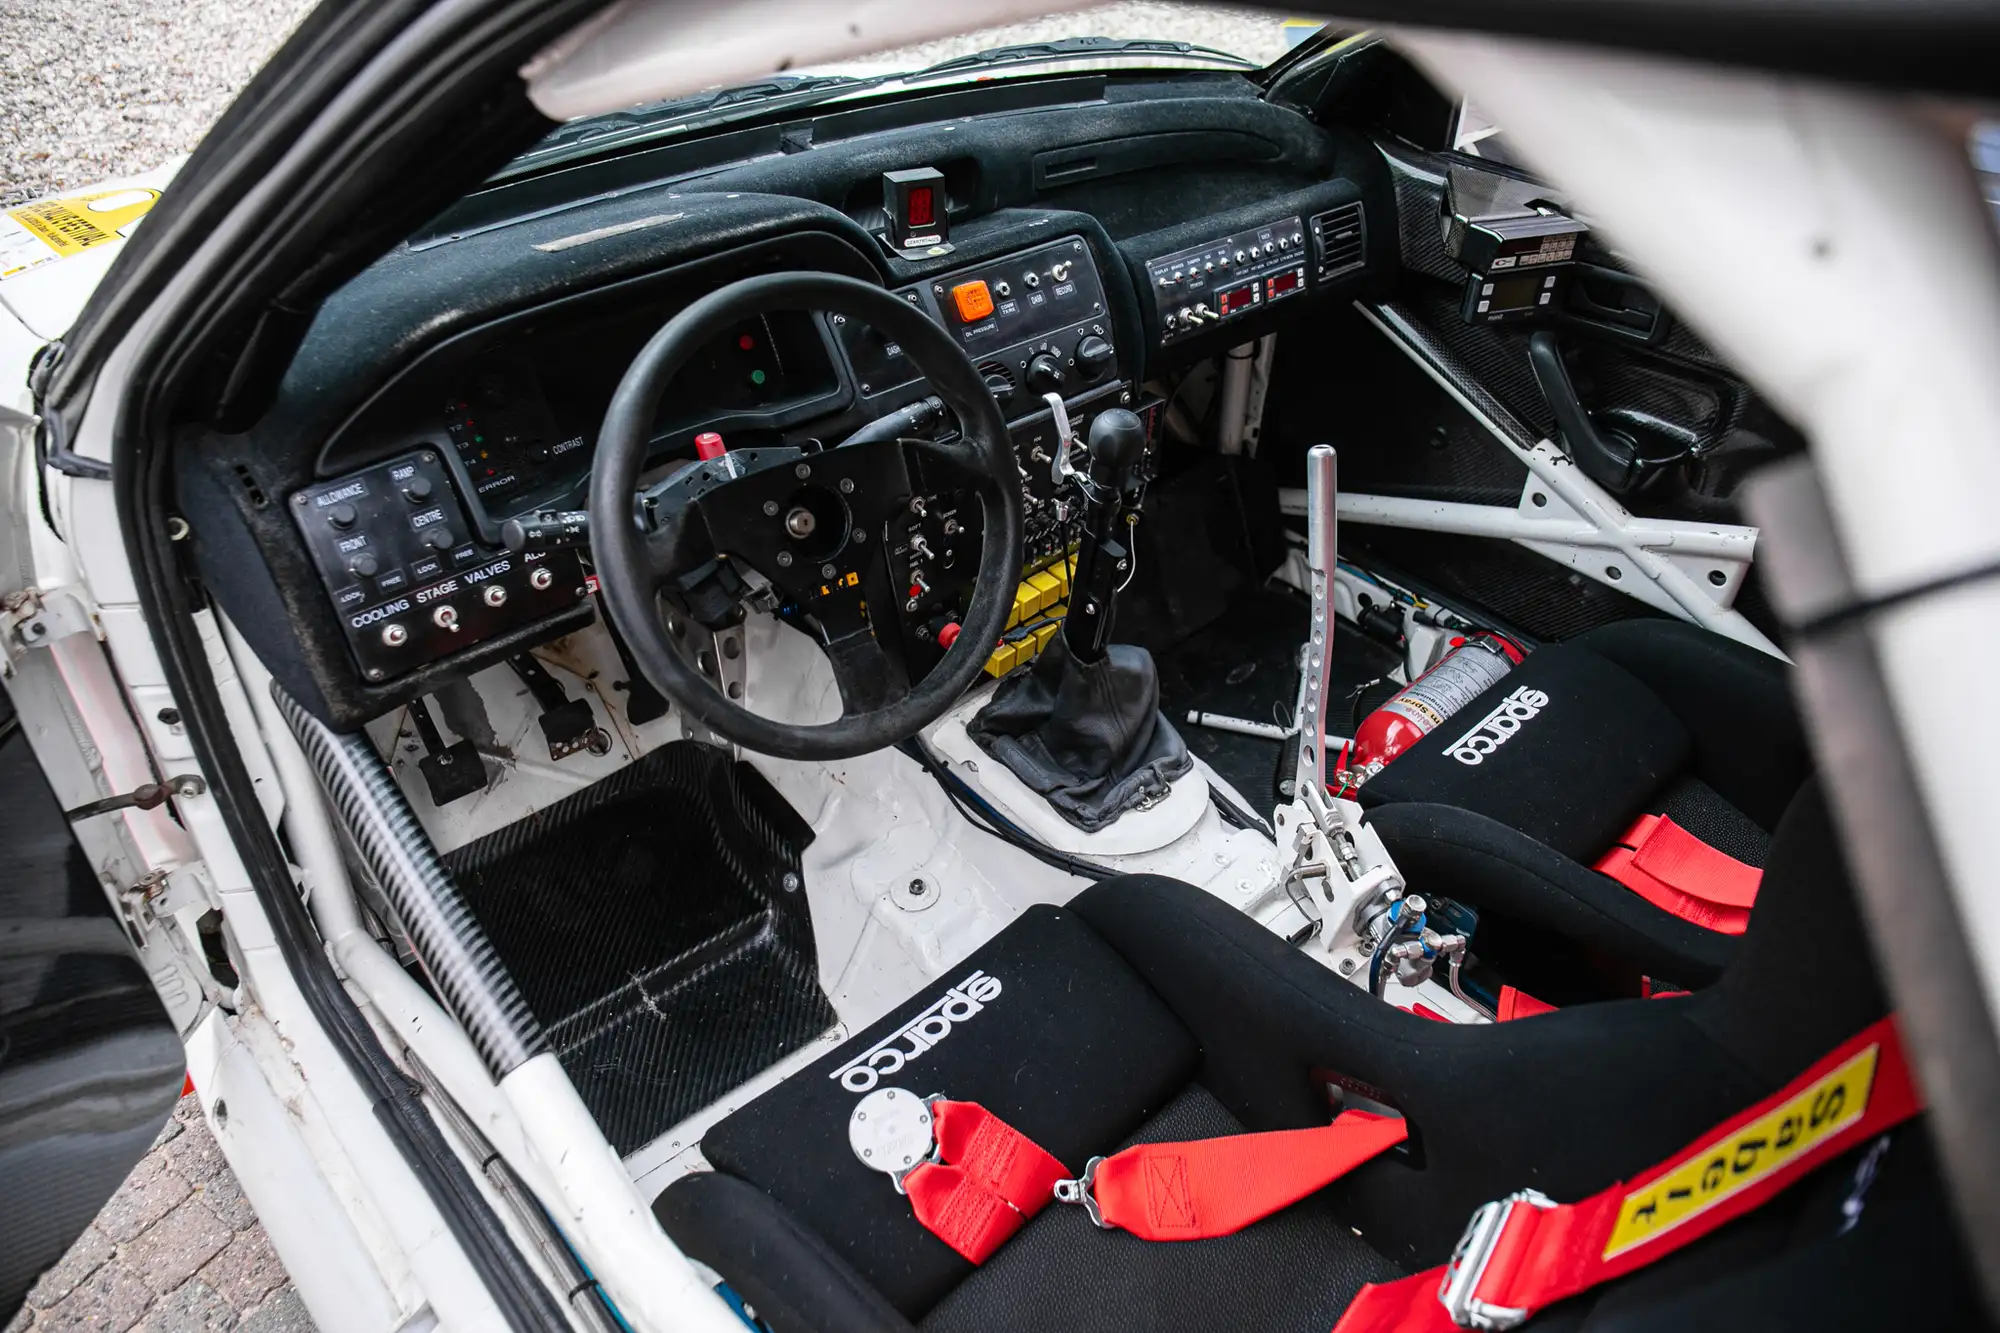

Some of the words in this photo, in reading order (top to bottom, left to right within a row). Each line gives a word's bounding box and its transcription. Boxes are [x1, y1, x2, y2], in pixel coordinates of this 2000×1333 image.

[1055, 284, 1073, 296] RECORD
[973, 323, 995, 334] PRESSURE
[552, 437, 584, 455] CONTRAST
[393, 465, 415, 481] RAMP
[478, 475, 515, 493] ERROR
[317, 482, 364, 507] ALLOWANCE
[413, 508, 443, 528] CENTRE
[339, 534, 366, 553] FRONT
[455, 548, 474, 561] FREE
[416, 561, 438, 575] LOCK
[382, 575, 402, 588] FREE
[340, 590, 363, 604] LOCK
[352, 599, 410, 629] COOLING
[416, 580, 459, 604] STAGE
[464, 560, 511, 585] VALVES
[1400, 697, 1429, 714] Spray
[1442, 686, 1549, 765] sparco
[829, 969, 1003, 1092] sparco
[1630, 1083, 1847, 1226] Sabelt
